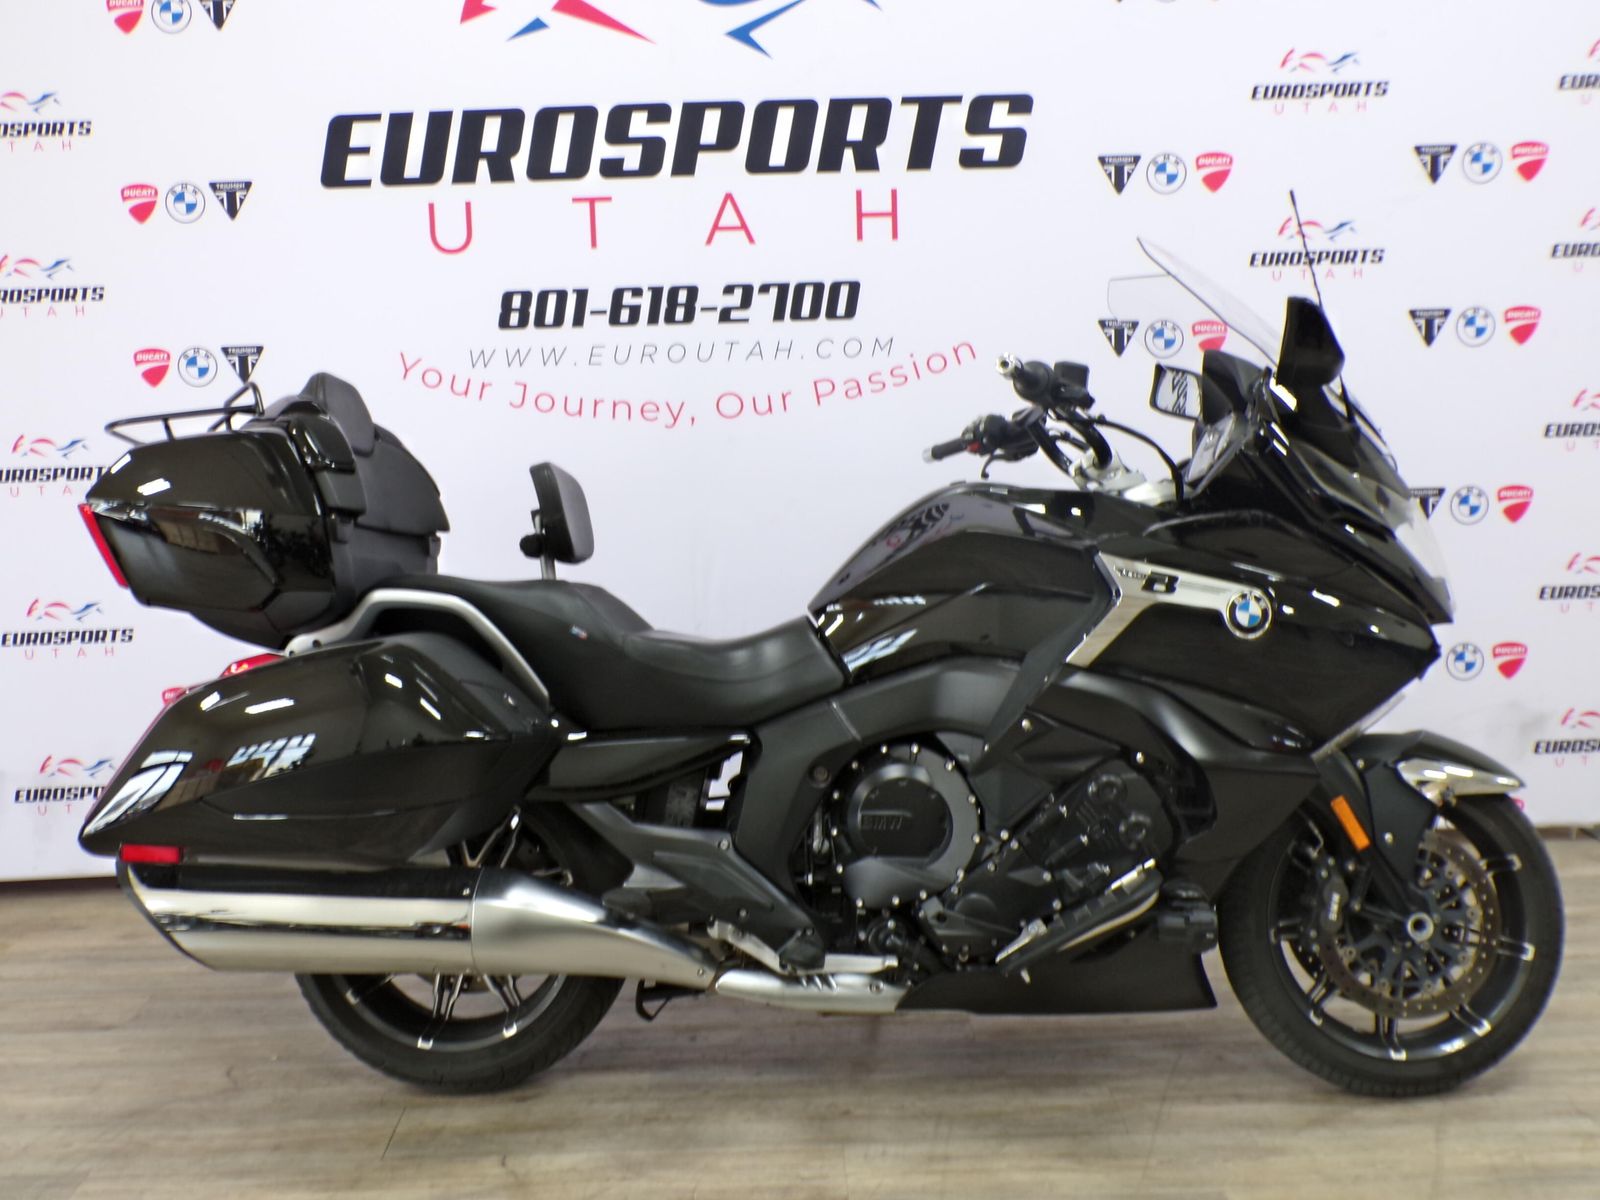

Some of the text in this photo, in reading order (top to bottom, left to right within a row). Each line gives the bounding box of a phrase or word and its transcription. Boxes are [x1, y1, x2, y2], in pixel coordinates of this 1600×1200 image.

[1252, 82, 1388, 100] EUROSPORTS
[321, 94, 1034, 188] EUROSPORTS
[123, 188, 156, 198] DUCATI
[428, 188, 899, 255] UTAH
[1249, 249, 1386, 267] EUROSPORTS
[498, 281, 861, 330] 801-618-2700
[470, 336, 894, 369] WWW.EUROUTAH.COM
[400, 340, 977, 429] Your Journey, Our Passion
[1, 628, 134, 647] EUROSPORTS
